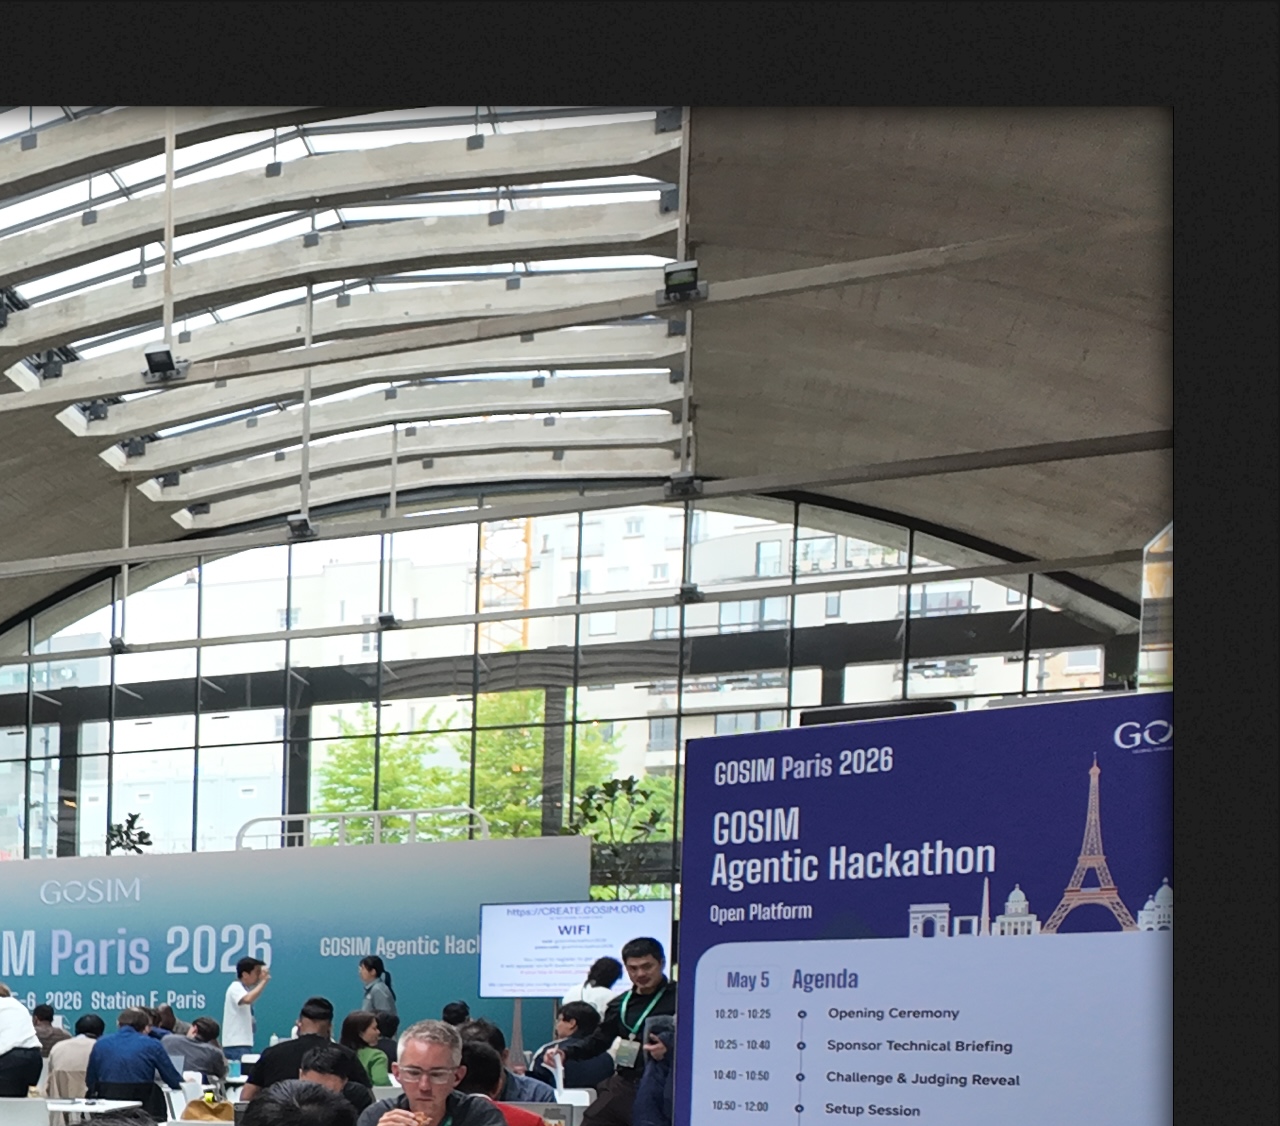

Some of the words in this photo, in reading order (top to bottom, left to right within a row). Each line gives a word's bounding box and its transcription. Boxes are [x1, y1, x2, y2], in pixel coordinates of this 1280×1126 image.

[714, 757, 775, 786] GOSIM
[781, 753, 833, 780] Paris
[839, 746, 894, 775] 2026
[713, 807, 800, 846] GOSIM
[710, 848, 819, 892] Agentic
[829, 839, 996, 881] Hackathon
[40, 877, 141, 905] GOSIM
[710, 903, 745, 926] Open
[749, 902, 813, 922] Platform
[558, 924, 591, 935] WIFI
[51, 927, 150, 976] Paris
[165, 923, 273, 976] 2026
[320, 936, 371, 957] GOSIM
[375, 934, 440, 959] Agentic
[726, 971, 756, 992] May
[761, 971, 770, 988] 5
[792, 968, 859, 993] Agenda
[46, 991, 82, 1011] 2026
[91, 990, 145, 1010] Station
[169, 989, 206, 1010] Paris
[828, 1007, 884, 1022] Opening
[888, 1007, 960, 1021] Ceremony
[827, 1039, 883, 1052] Sponsor
[886, 1040, 951, 1052] Technical
[955, 1040, 1013, 1055] Briefing
[826, 1071, 893, 1086] Challenge
[897, 1073, 907, 1084] &
[911, 1073, 968, 1088] Judging
[972, 1074, 1020, 1086] Reveal
[825, 1103, 864, 1117] Setup
[868, 1104, 921, 1117] Session
